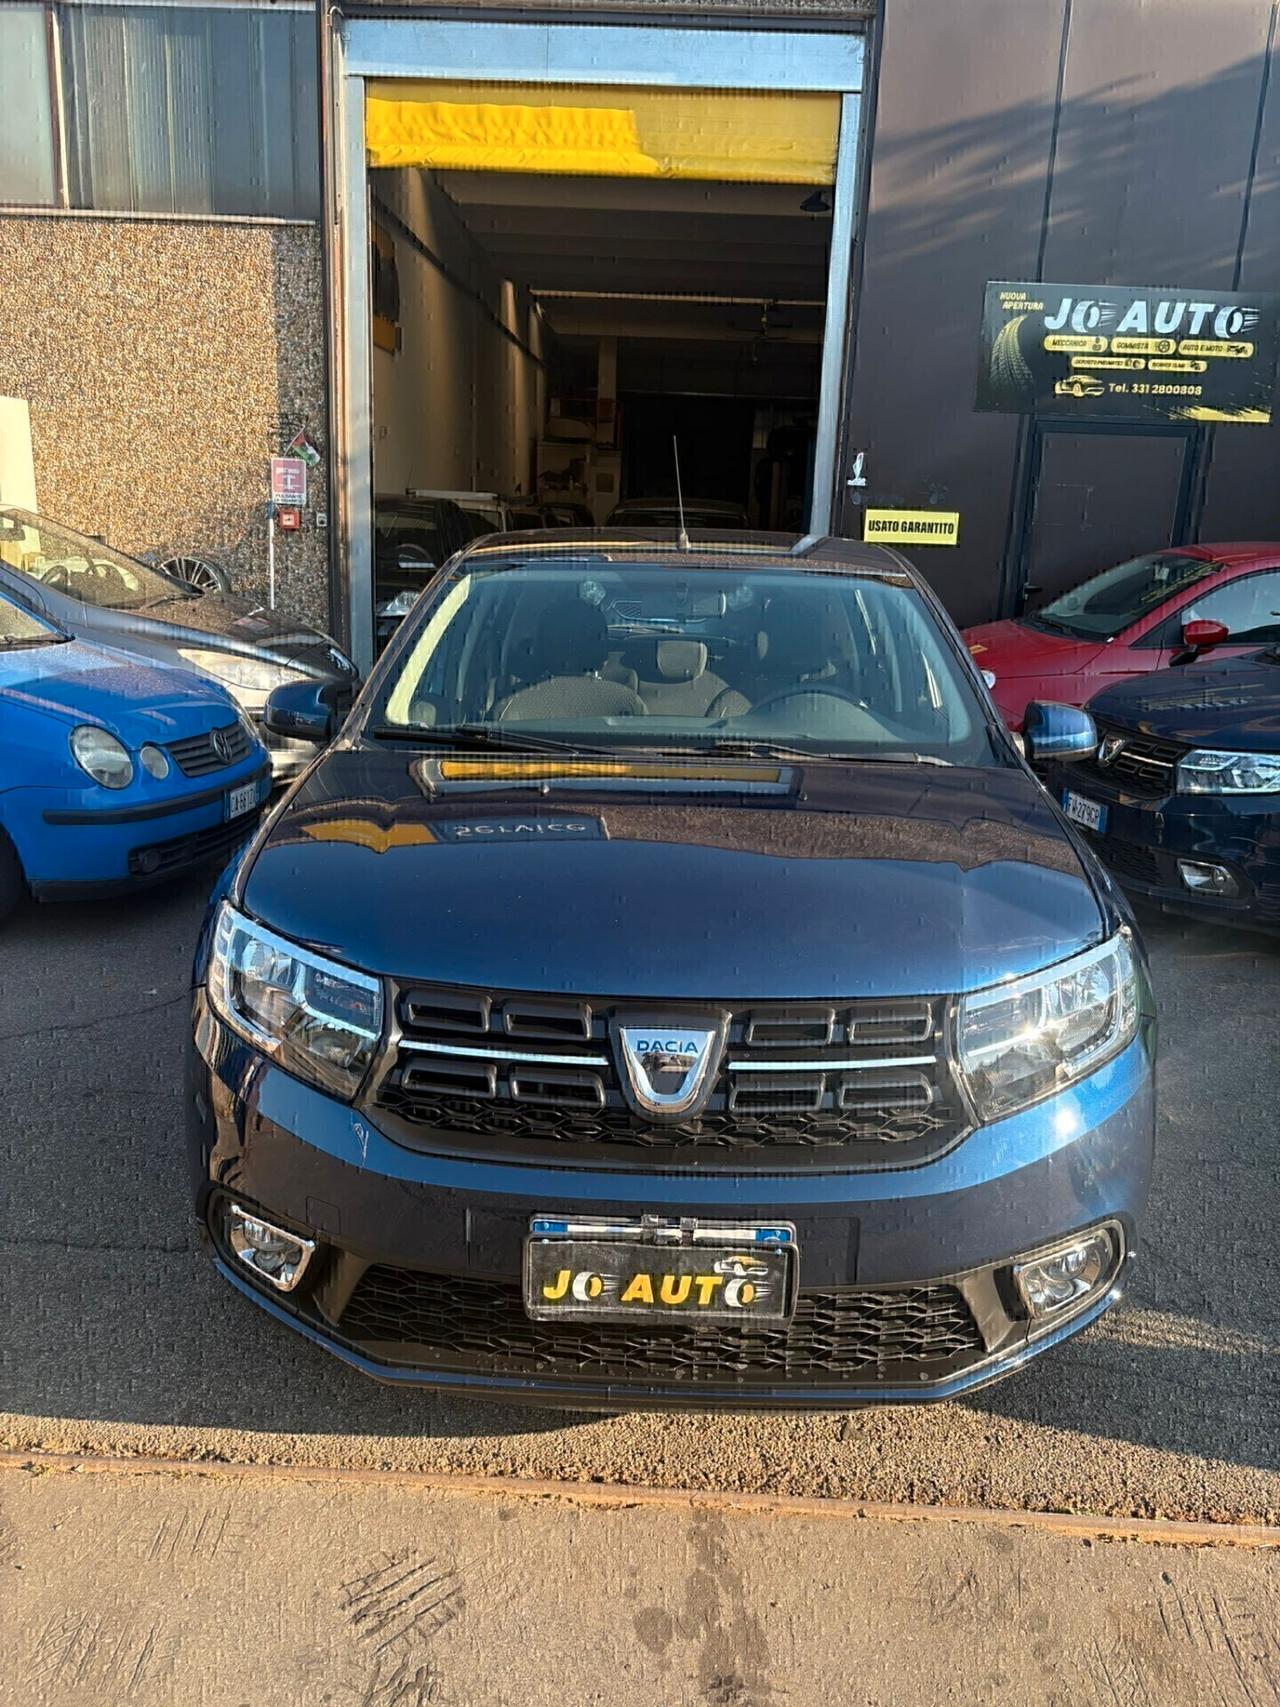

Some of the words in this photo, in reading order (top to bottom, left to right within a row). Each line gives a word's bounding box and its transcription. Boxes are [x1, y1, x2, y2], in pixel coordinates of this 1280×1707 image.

[1000, 292, 1026, 300] NUOVA
[1002, 301, 1044, 310] APERTURA
[1116, 300, 1244, 338] AUTO
[1108, 383, 1129, 393] Tel.
[1131, 384, 1150, 394] 331
[1151, 385, 1202, 395] 2800808
[868, 520, 899, 532] USATO
[901, 521, 954, 534] GARANTITO
[636, 1040, 699, 1053] DACIA
[620, 1273, 755, 1308] AUTO
